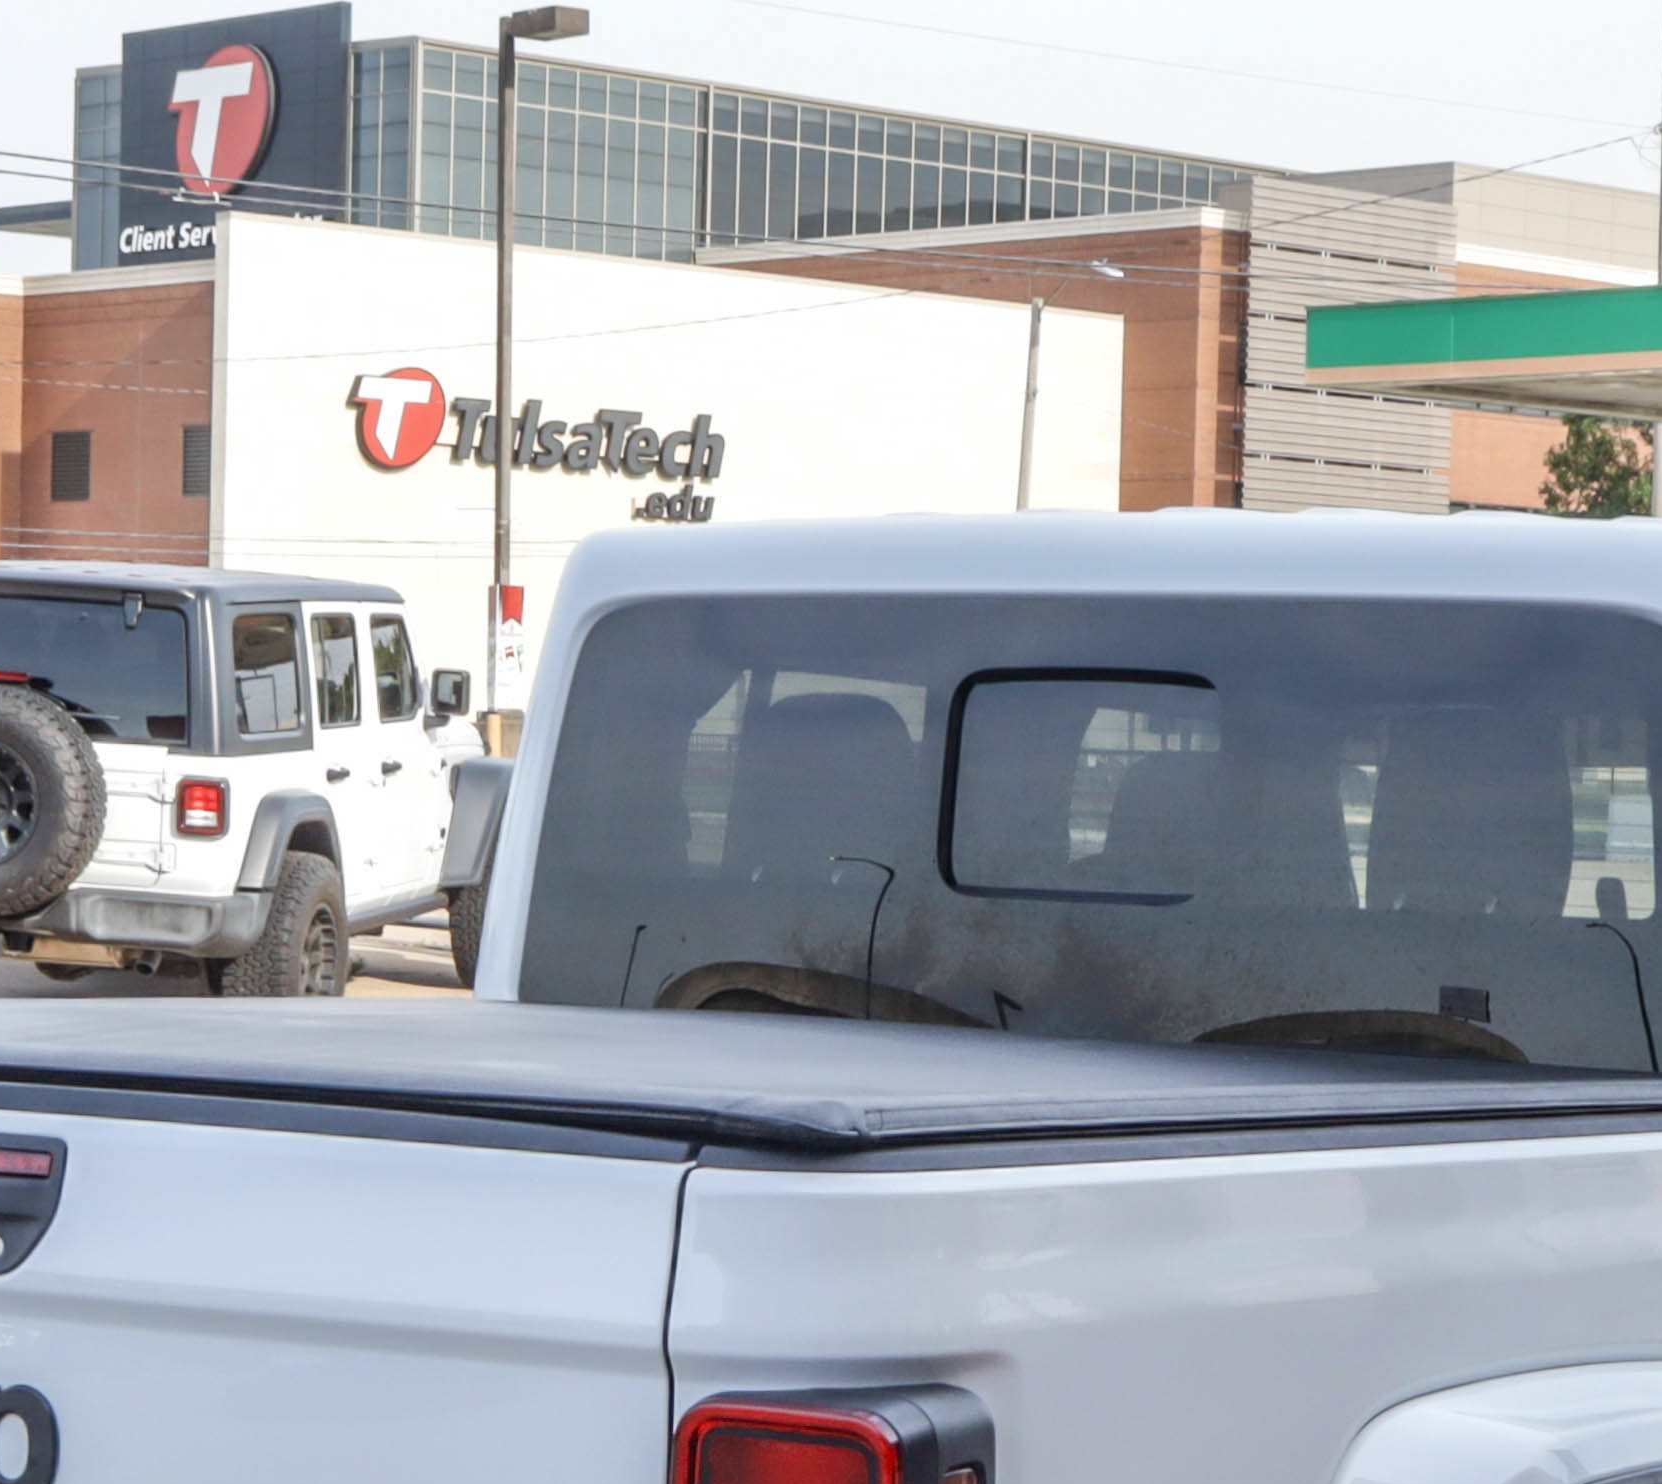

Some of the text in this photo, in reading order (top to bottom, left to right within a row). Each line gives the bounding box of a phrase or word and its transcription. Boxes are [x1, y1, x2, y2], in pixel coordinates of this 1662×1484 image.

[119, 224, 174, 254] Client
[451, 397, 725, 480] TulsaTech
[637, 484, 714, 521] .edu
